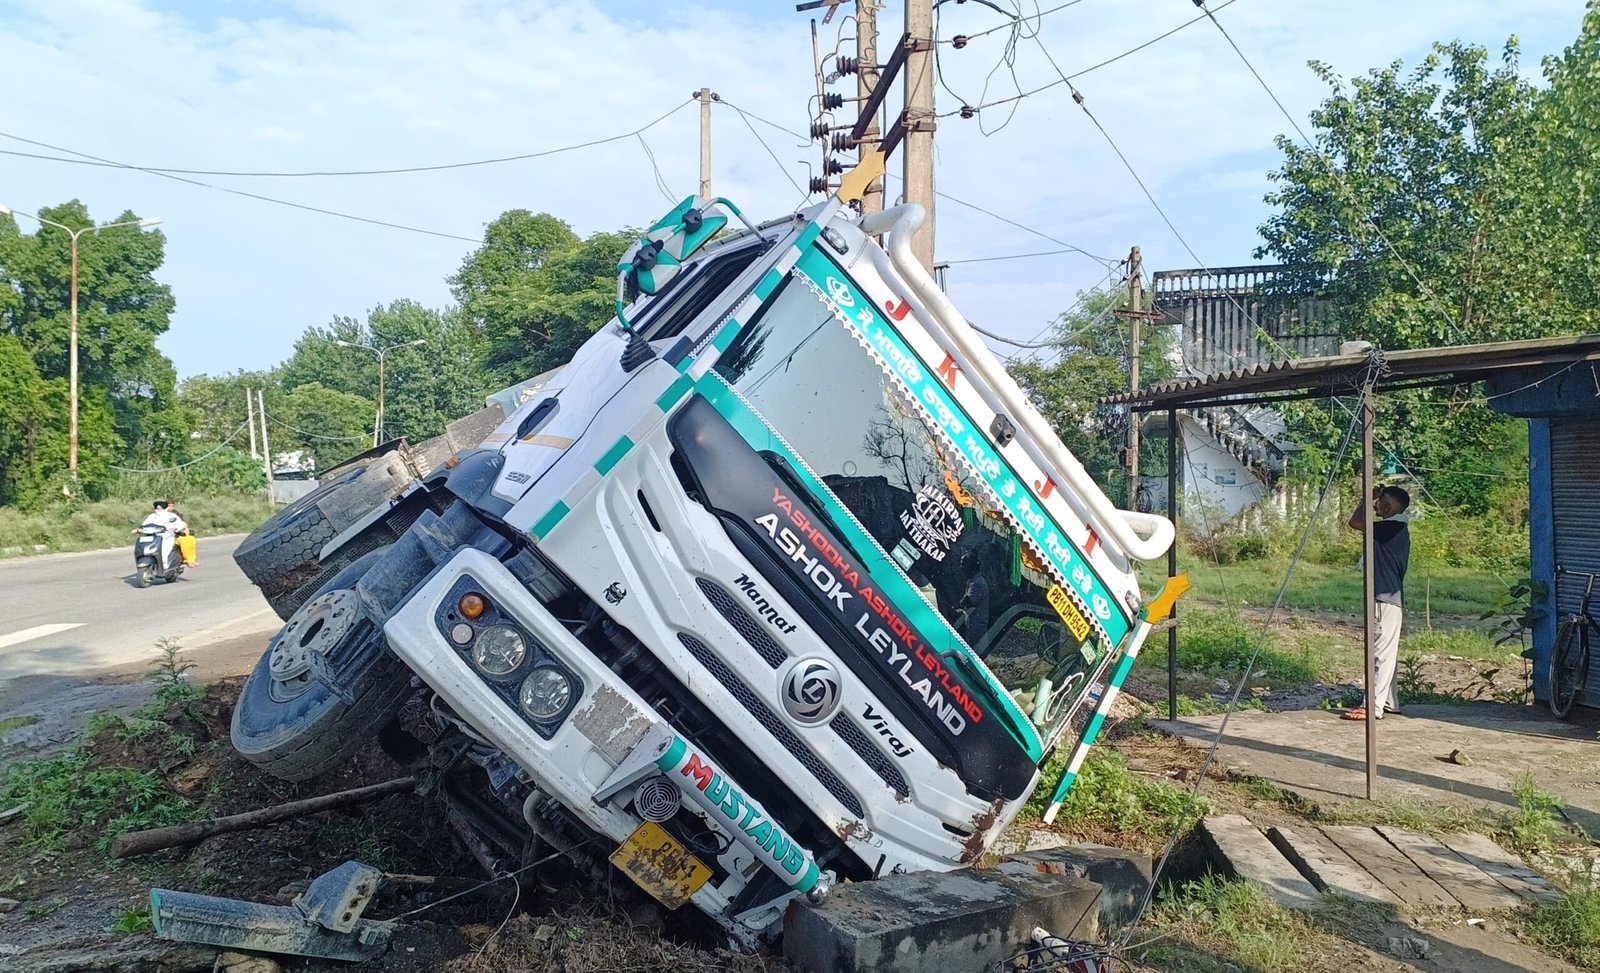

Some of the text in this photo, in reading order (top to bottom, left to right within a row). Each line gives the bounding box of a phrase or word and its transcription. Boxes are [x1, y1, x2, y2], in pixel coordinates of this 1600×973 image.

[899, 509, 912, 530] JAI
[908, 524, 946, 562] THAKAR
[935, 491, 965, 535] KIRPAL
[733, 573, 798, 635] Mannat
[754, 512, 966, 736] ASHOK LEYLAND
[772, 484, 983, 724] YASHODHA ASHOK LEYLAND
[862, 702, 915, 758] Viraj
[680, 753, 805, 876] MUSTANG
